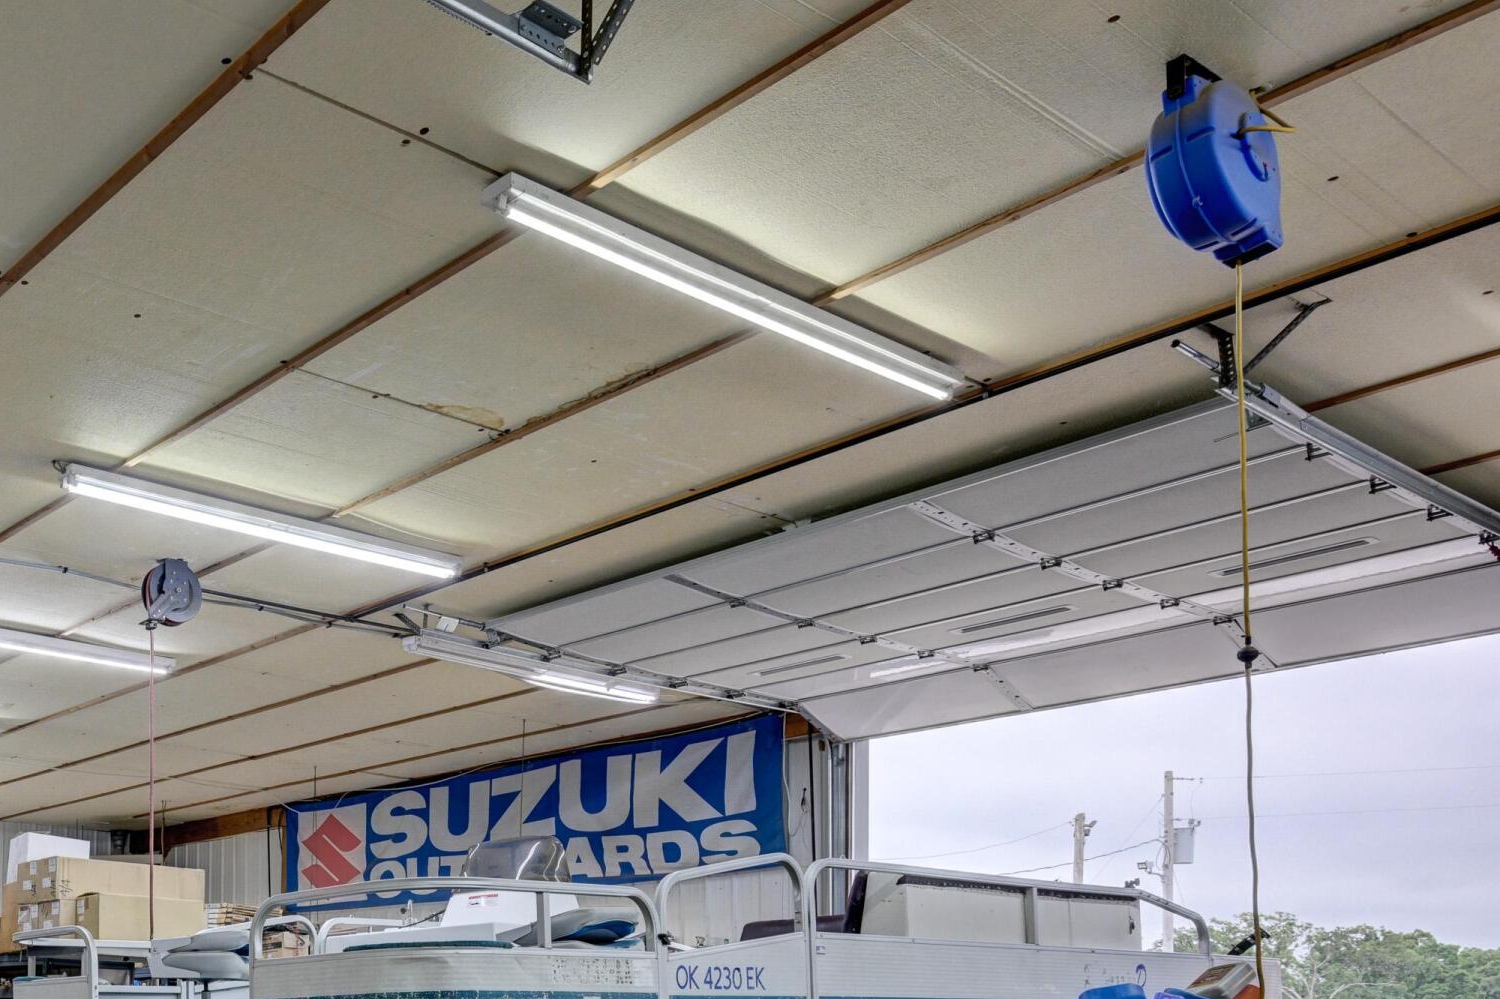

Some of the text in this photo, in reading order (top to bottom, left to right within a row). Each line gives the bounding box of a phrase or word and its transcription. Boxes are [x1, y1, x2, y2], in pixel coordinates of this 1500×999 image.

[370, 729, 757, 859] SUZUKI
[675, 964, 766, 991] OK 4230 EK
